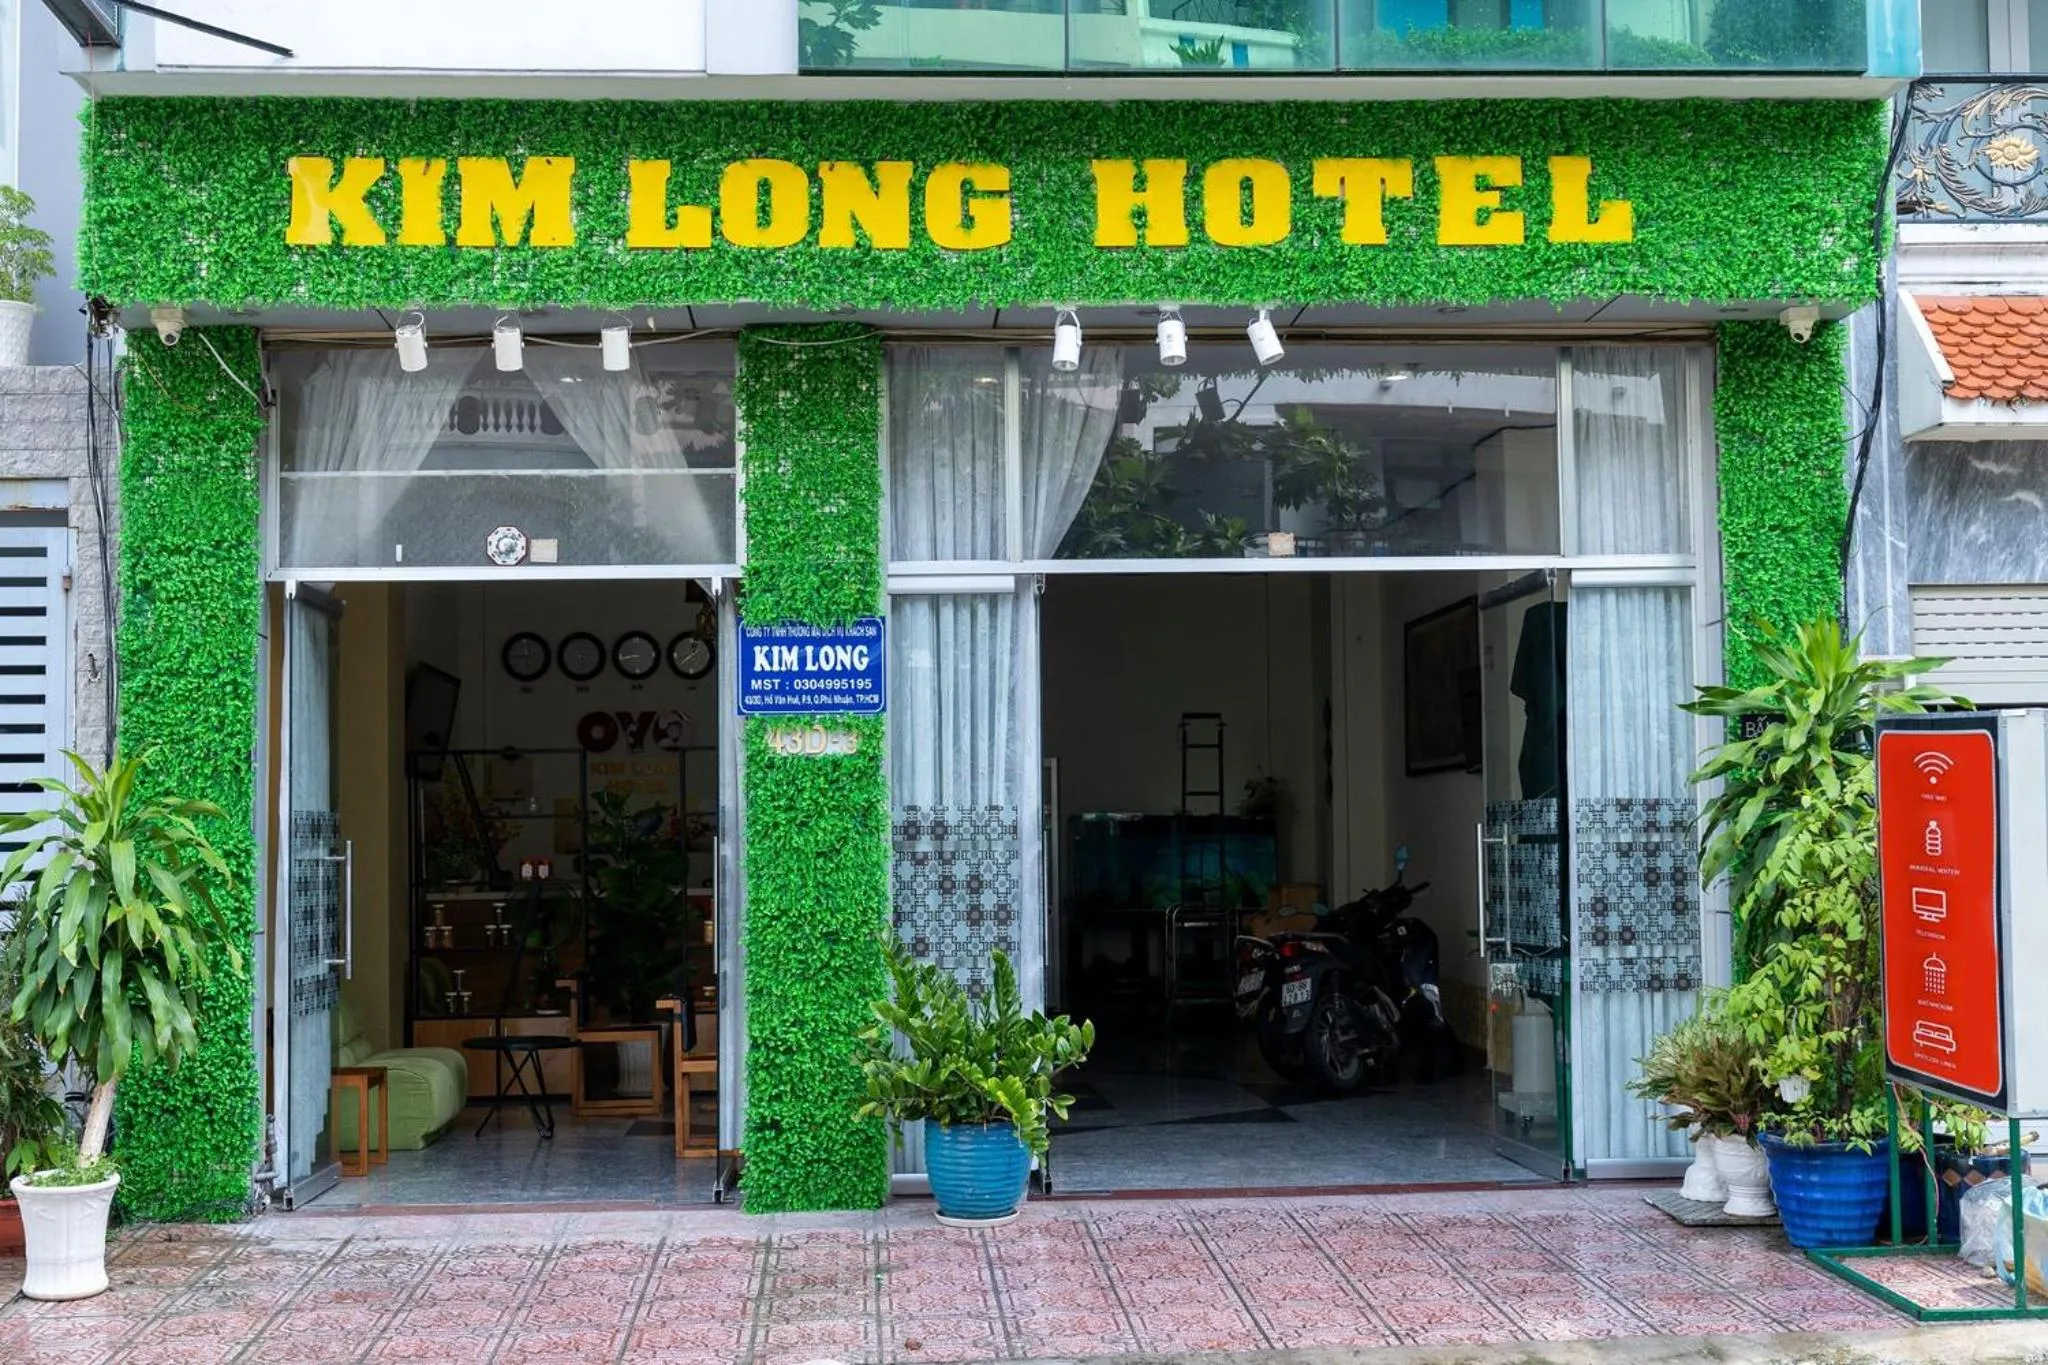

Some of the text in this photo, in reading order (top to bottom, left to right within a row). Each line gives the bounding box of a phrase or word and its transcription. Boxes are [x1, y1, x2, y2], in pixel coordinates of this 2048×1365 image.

[284, 154, 1634, 250] KIM LONG HOTEL
[753, 645, 869, 672] KIM LONG
[751, 679, 782, 690] MST
[793, 679, 872, 690] 0304995195
